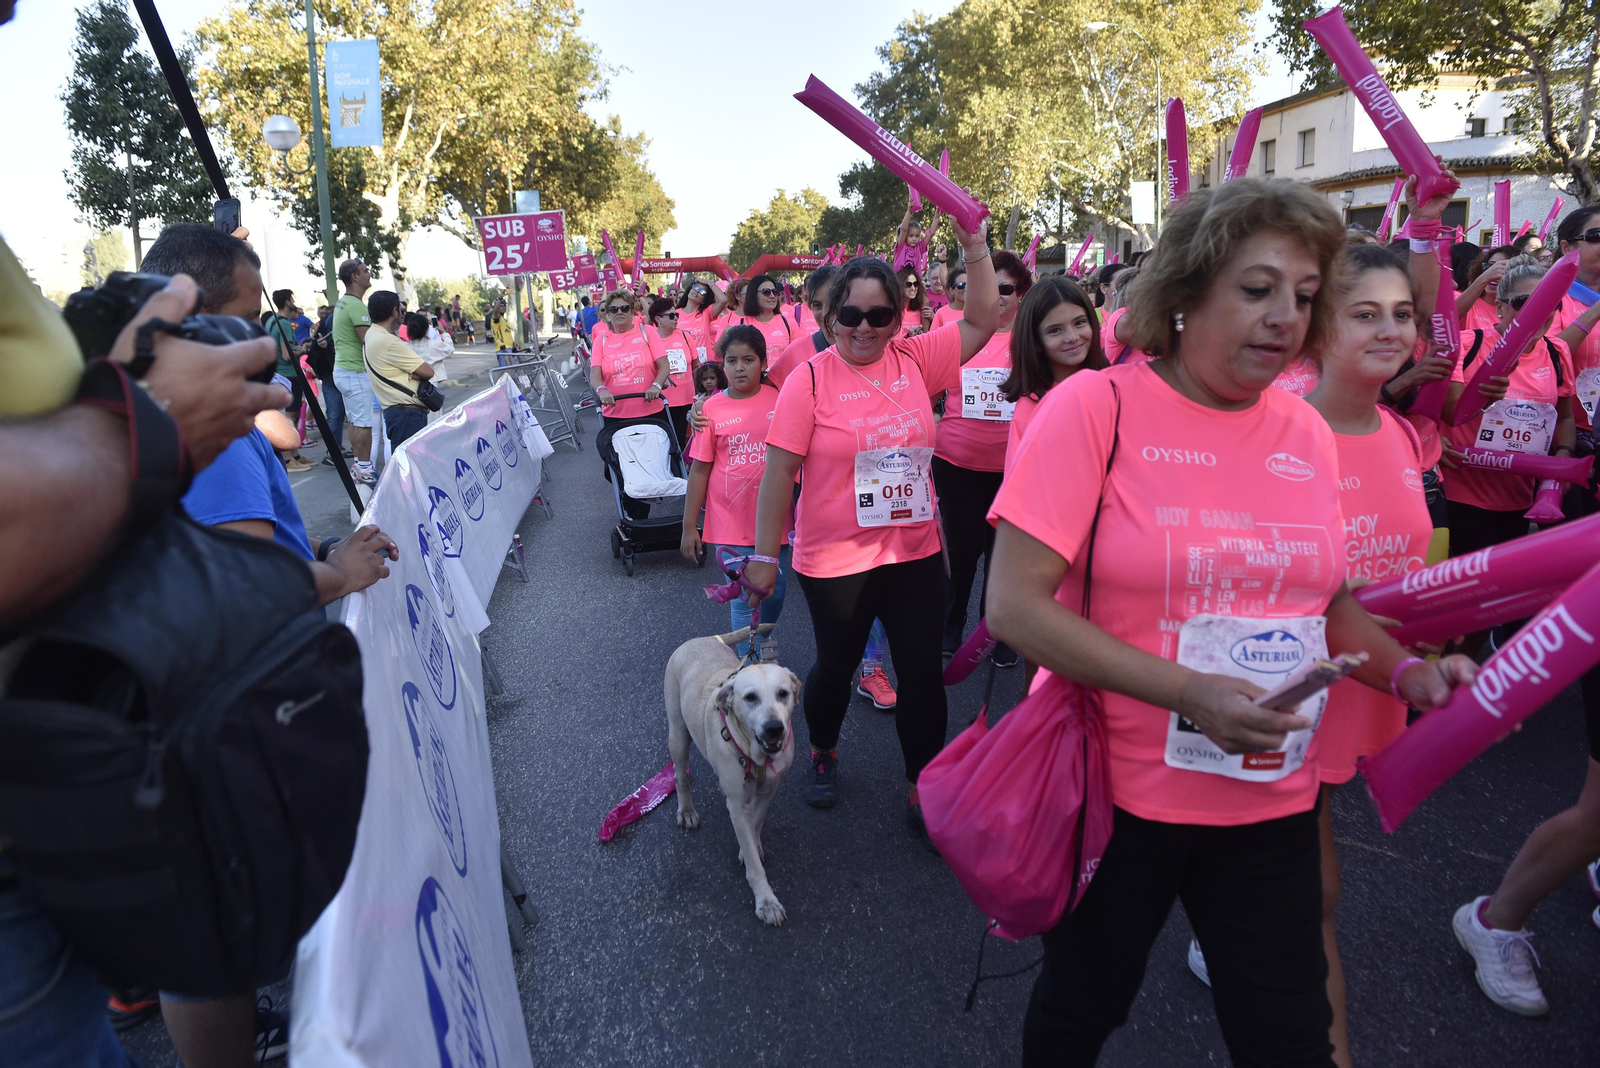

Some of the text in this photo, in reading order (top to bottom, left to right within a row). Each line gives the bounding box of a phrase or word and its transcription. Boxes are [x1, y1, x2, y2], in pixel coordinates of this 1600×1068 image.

[334, 78, 370, 86] PASQUALE
[1355, 73, 1403, 131] Ladival
[484, 220, 525, 239] SUB
[537, 234, 563, 242] OYSHO
[486, 242, 531, 270] 25'
[556, 271, 579, 288] 35'
[839, 390, 870, 401] OYSHO
[980, 391, 1005, 402] 016
[1508, 408, 1537, 419] ASTURIANA
[715, 417, 742, 430] OYSHO
[877, 424, 897, 436] VITORIA
[728, 432, 750, 446] HOY
[889, 428, 909, 438] MADRID
[1502, 428, 1532, 442] 016
[728, 442, 767, 456] GANAN
[730, 454, 747, 466] LAS
[1142, 446, 1217, 467] OYSHO
[880, 461, 911, 469] ASTURIANA
[1271, 462, 1313, 476] ASTURIANA
[882, 483, 914, 499] 016
[891, 500, 908, 509] 2318
[1156, 506, 1255, 530] HOY GANAN
[1344, 514, 1379, 539] HOY
[1220, 538, 1266, 553] VITORIA
[1275, 541, 1320, 556] GASTEIZ
[1346, 533, 1411, 563] GANAN
[1246, 553, 1292, 567] MADRID
[1346, 560, 1373, 580] LAS
[1402, 546, 1495, 595] Ladival
[1237, 644, 1300, 663] ASTURIANA
[1470, 603, 1595, 719] Ladival
[1177, 747, 1225, 762] OYSHO
